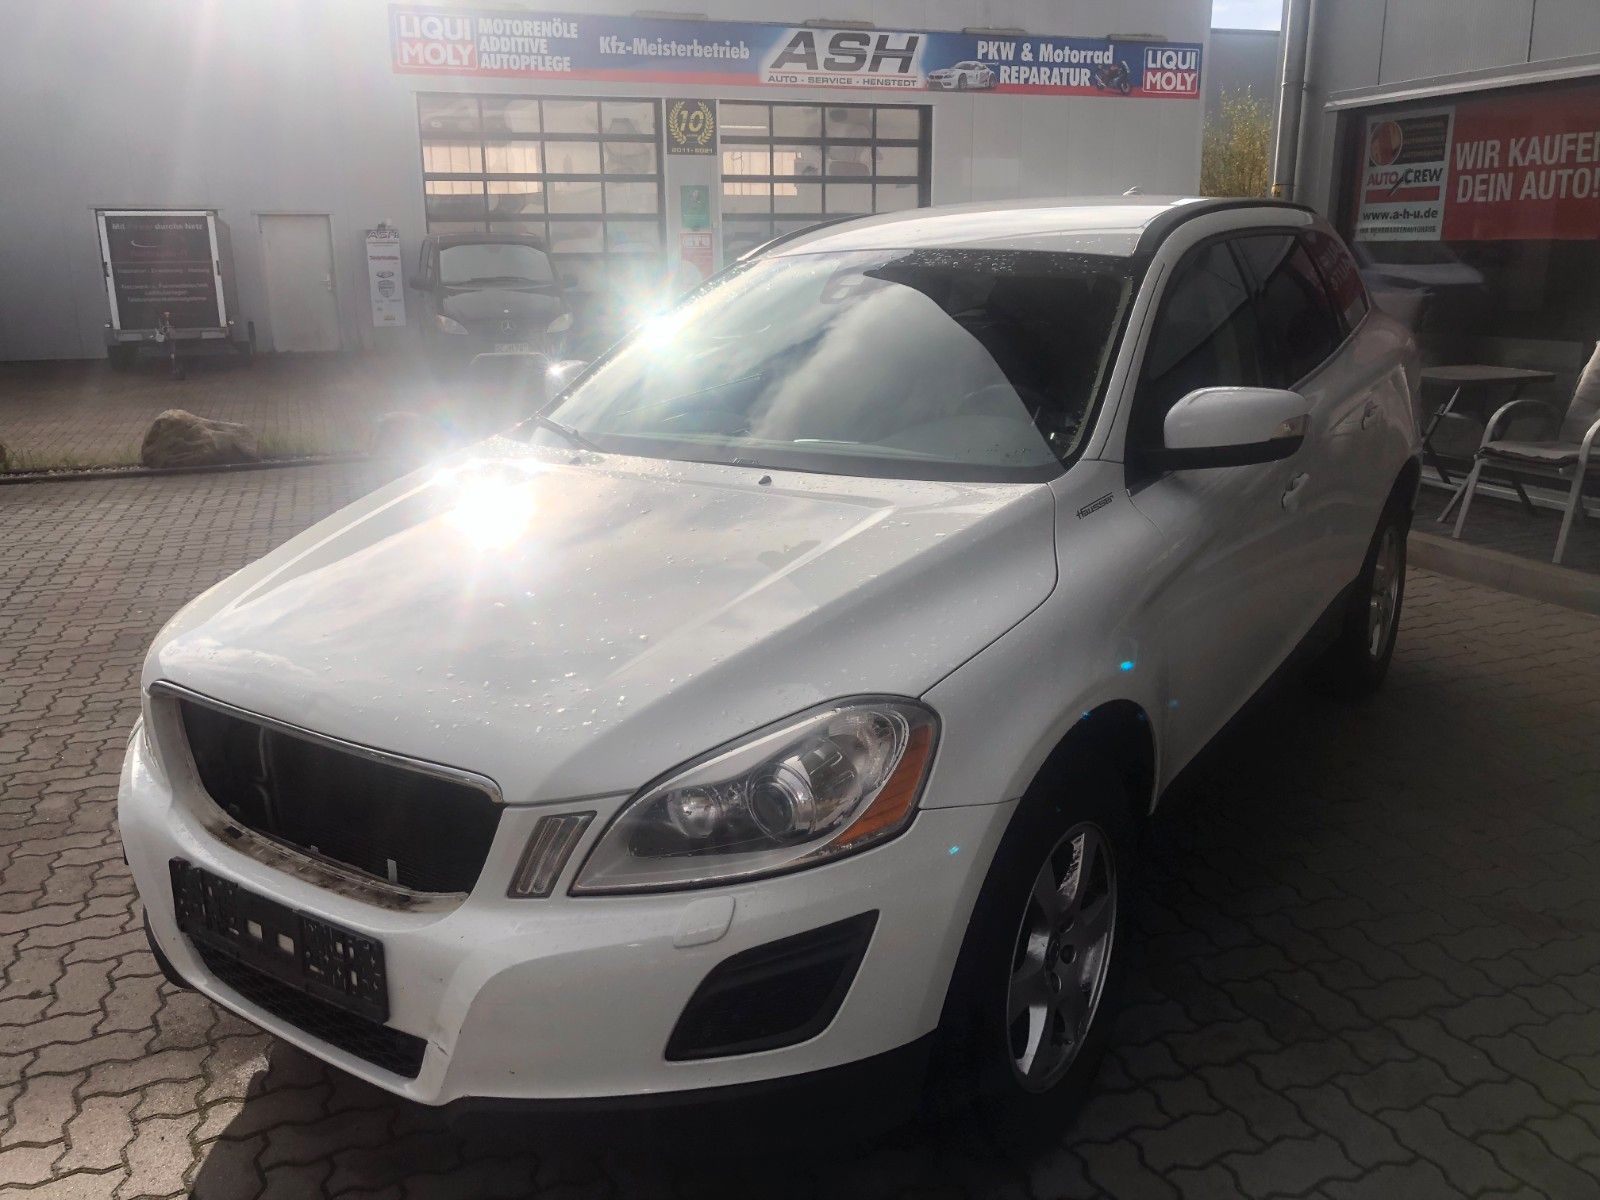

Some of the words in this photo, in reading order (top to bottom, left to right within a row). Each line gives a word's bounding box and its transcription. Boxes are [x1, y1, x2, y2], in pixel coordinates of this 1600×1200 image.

[399, 16, 471, 40] LIQUI
[478, 18, 578, 39] MOTORENÖLE
[400, 41, 475, 66] MOLY
[479, 36, 548, 55] ADDITIVE
[599, 35, 751, 60] Kfz-Meisterbetrieb
[769, 31, 920, 73] ASH
[977, 40, 1016, 60] PKW
[1021, 43, 1034, 62] &
[1039, 43, 1114, 64] Motorrad
[480, 53, 571, 72] AUTOPFLEGE
[1147, 48, 1196, 70] LIQUI
[768, 75, 798, 84] AUTO
[807, 76, 853, 86] SERVICE
[862, 77, 917, 87] HENSTEDT
[999, 65, 1091, 87] REPARATUR
[1146, 70, 1196, 92] MOLY
[680, 111, 705, 132] 10
[1456, 138, 1501, 170] WIR
[1456, 172, 1513, 203] DEIN
[1519, 167, 1600, 201] AUTO!
[1362, 207, 1439, 221] www.a-h-u.de
